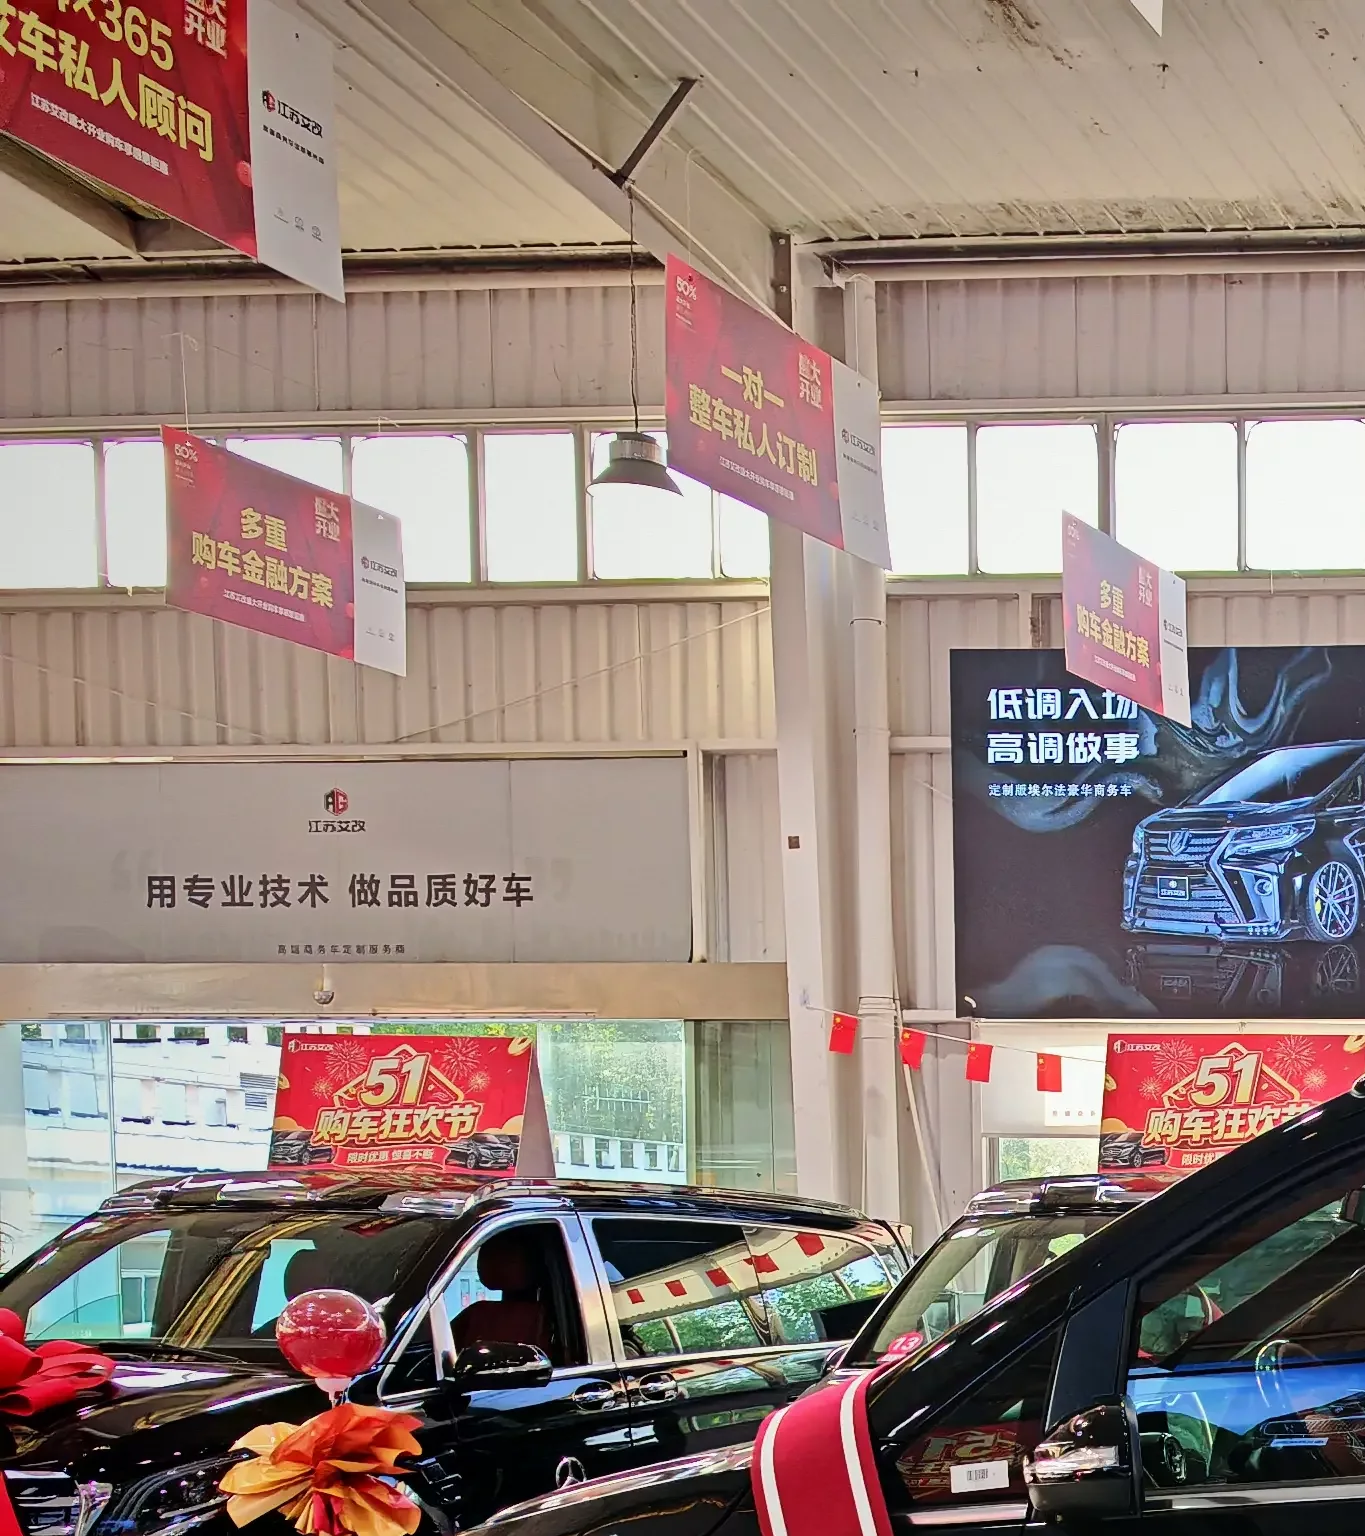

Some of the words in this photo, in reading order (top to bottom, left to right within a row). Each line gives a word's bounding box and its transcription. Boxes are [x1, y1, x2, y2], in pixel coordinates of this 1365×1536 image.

[184, 5, 228, 59] 开业
[720, 365, 785, 410] 一对一
[688, 383, 819, 487] 整车私人订制
[240, 507, 288, 552] 多重
[191, 531, 334, 609] 购车金融方案
[1100, 579, 1124, 619] 多重
[1076, 603, 1150, 669] 购车金融方案
[987, 688, 1138, 720] 低调入场
[987, 732, 1140, 764] 高调做事
[988, 783, 1132, 797] 定制版埃尔法豪华商务车
[308, 820, 366, 833] 江苏艾改
[146, 873, 330, 909] 用专业技术
[348, 872, 534, 908] 做品质好车
[361, 1055, 429, 1107] 51
[1191, 1053, 1261, 1107] 51
[315, 1105, 480, 1143] 购车狂欢节
[346, 1151, 389, 1163] 限时优惠
[391, 1149, 434, 1162] 惊喜不断
[892, 1336, 920, 1351] 13
